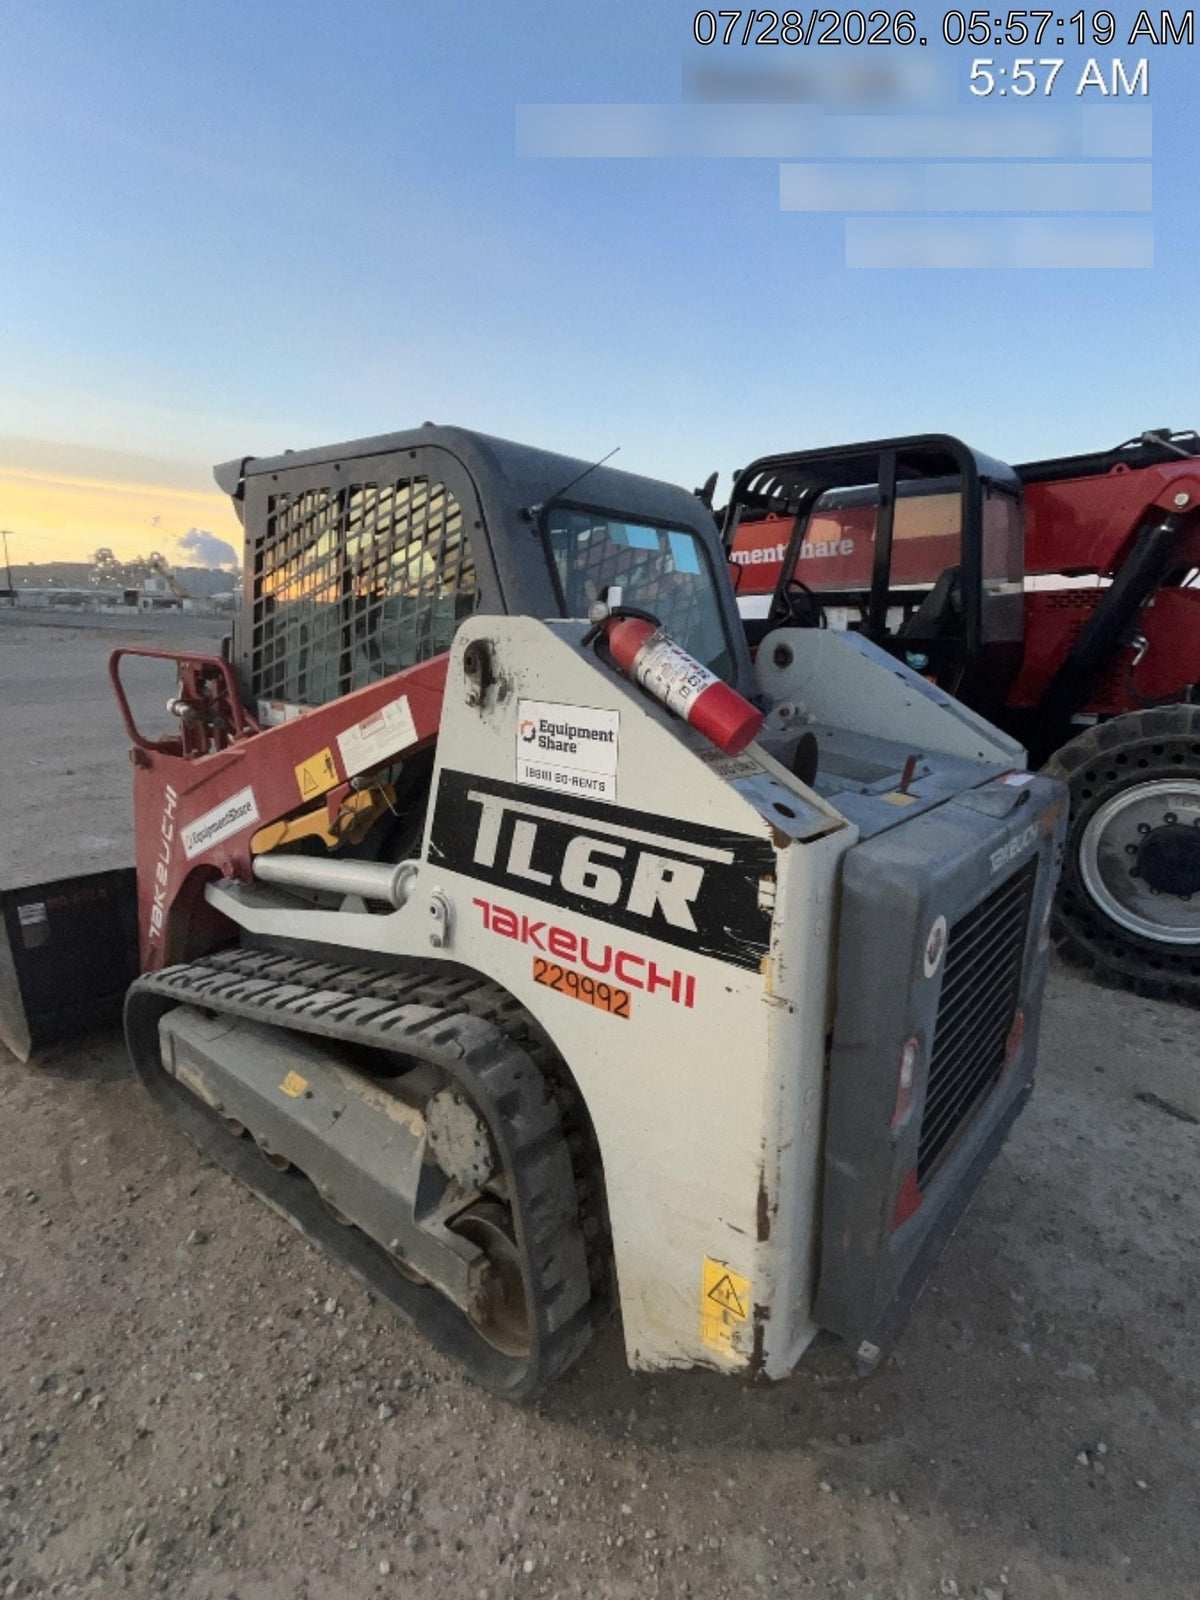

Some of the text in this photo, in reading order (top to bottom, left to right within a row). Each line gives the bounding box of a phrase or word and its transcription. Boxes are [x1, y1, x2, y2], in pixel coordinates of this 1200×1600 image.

[538, 719, 614, 743] Equipment
[538, 735, 577, 754] Share
[467, 790, 735, 932] TL6R
[534, 958, 630, 1019] 229992
